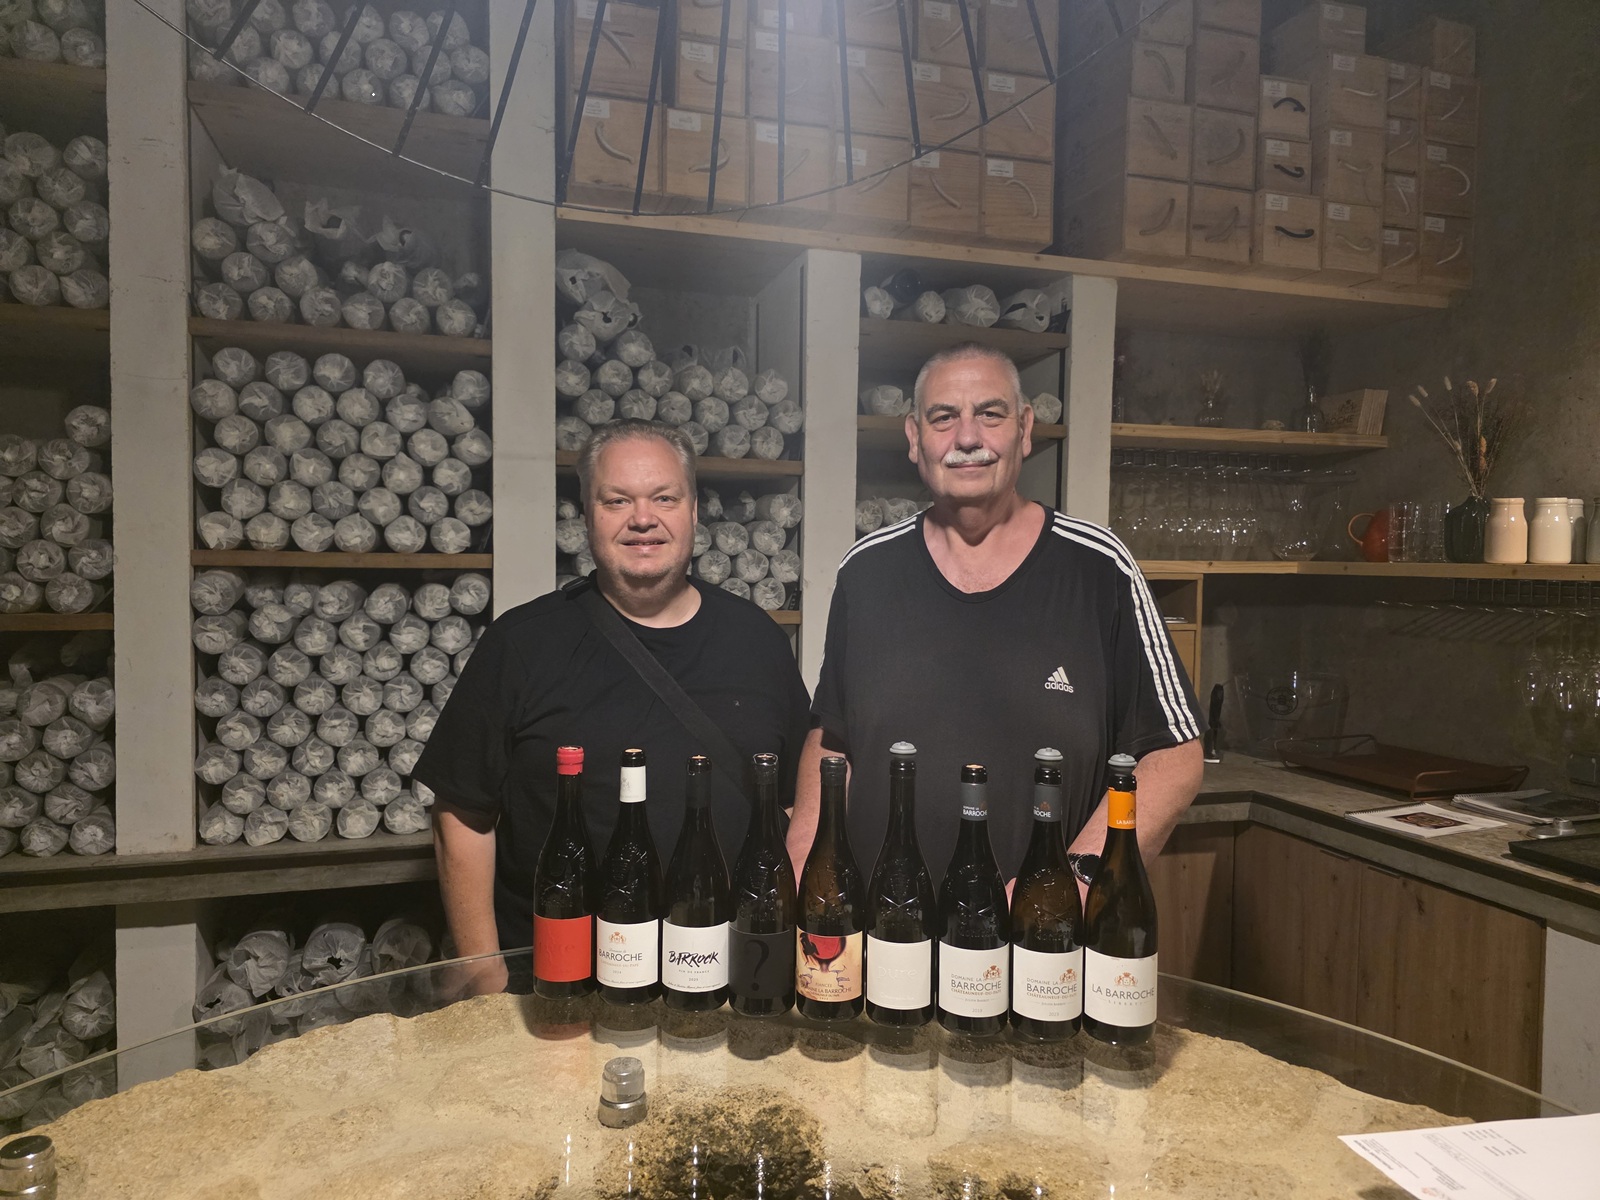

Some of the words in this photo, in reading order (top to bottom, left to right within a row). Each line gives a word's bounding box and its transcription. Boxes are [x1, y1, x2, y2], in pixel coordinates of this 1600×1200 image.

[1044, 681, 1074, 693] adidas
[599, 949, 643, 962] BARROCHE
[950, 979, 1002, 992] BARROCHE
[1026, 977, 1051, 986] DOMAINE
[1026, 983, 1078, 996] BARROCHE
[1091, 983, 1103, 996] LA
[1105, 987, 1155, 1000] BARROCHE
